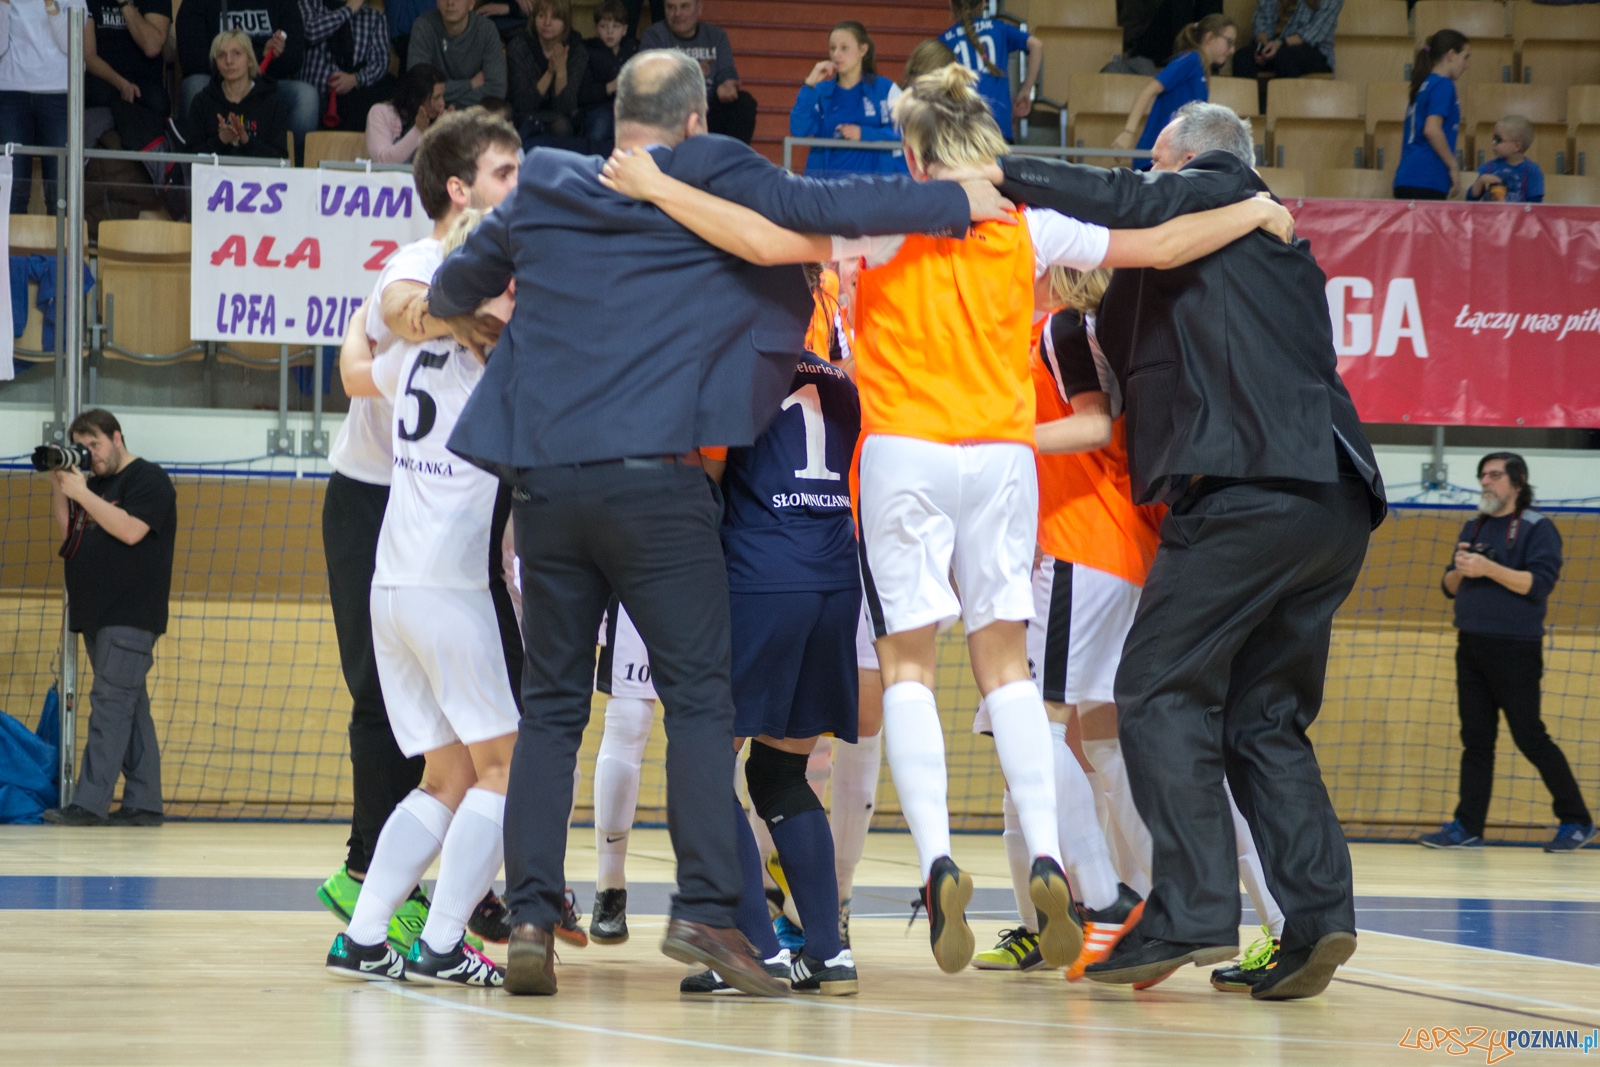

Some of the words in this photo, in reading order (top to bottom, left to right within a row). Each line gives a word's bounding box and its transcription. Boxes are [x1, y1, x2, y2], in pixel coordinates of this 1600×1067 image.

[207, 180, 288, 214] AZS
[320, 184, 413, 218] UAM
[210, 234, 321, 269] ALA
[216, 292, 275, 336] LPFA
[1454, 304, 1521, 339] Łączy
[1520, 313, 1562, 334] nas
[794, 361, 845, 379] elaria.pl
[398, 350, 451, 442] 5
[780, 383, 841, 481] 1
[623, 662, 651, 683] 10
